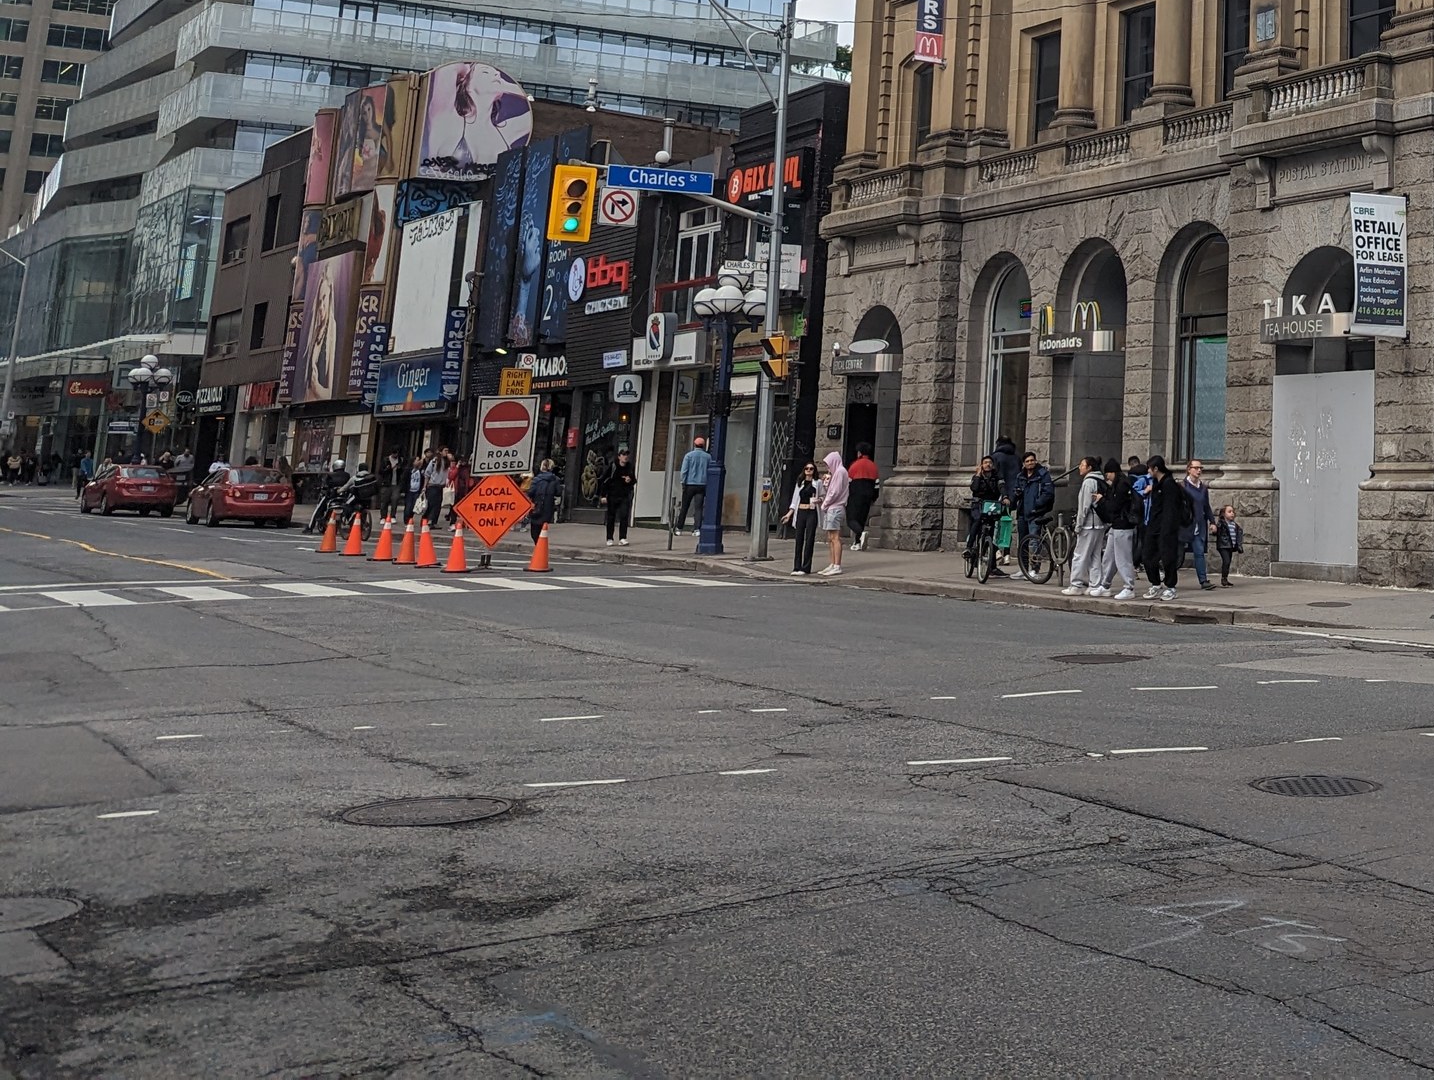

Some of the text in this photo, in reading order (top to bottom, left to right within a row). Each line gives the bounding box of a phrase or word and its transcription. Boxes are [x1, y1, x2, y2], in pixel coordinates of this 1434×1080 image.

[1278, 164, 1317, 184] POSTAL
[1320, 154, 1364, 176] STATION
[629, 169, 697, 187] Charles St
[1353, 206, 1375, 216] CBRE
[1354, 219, 1404, 237] RETAIL/
[1355, 235, 1401, 252] OFFICE
[548, 249, 568, 263] ROOM
[1356, 250, 1404, 263] FOR LEASE
[726, 261, 750, 269] CHARLES
[542, 284, 554, 321] 2
[1263, 292, 1336, 320] TIKA
[1358, 306, 1403, 317] 416 362 2244
[1265, 319, 1324, 337] TEA HOUSE
[444, 309, 466, 370] GINGER
[366, 325, 387, 380] GINGER
[540, 354, 568, 377] KABO
[397, 362, 431, 392] Ginger
[507, 371, 528, 379] RIGHT
[487, 450, 518, 458] ROAD
[479, 461, 523, 470] CLOSED
[479, 487, 512, 496] LOCAL
[474, 502, 516, 512] TRAFFIC
[478, 517, 507, 527] ONLY
